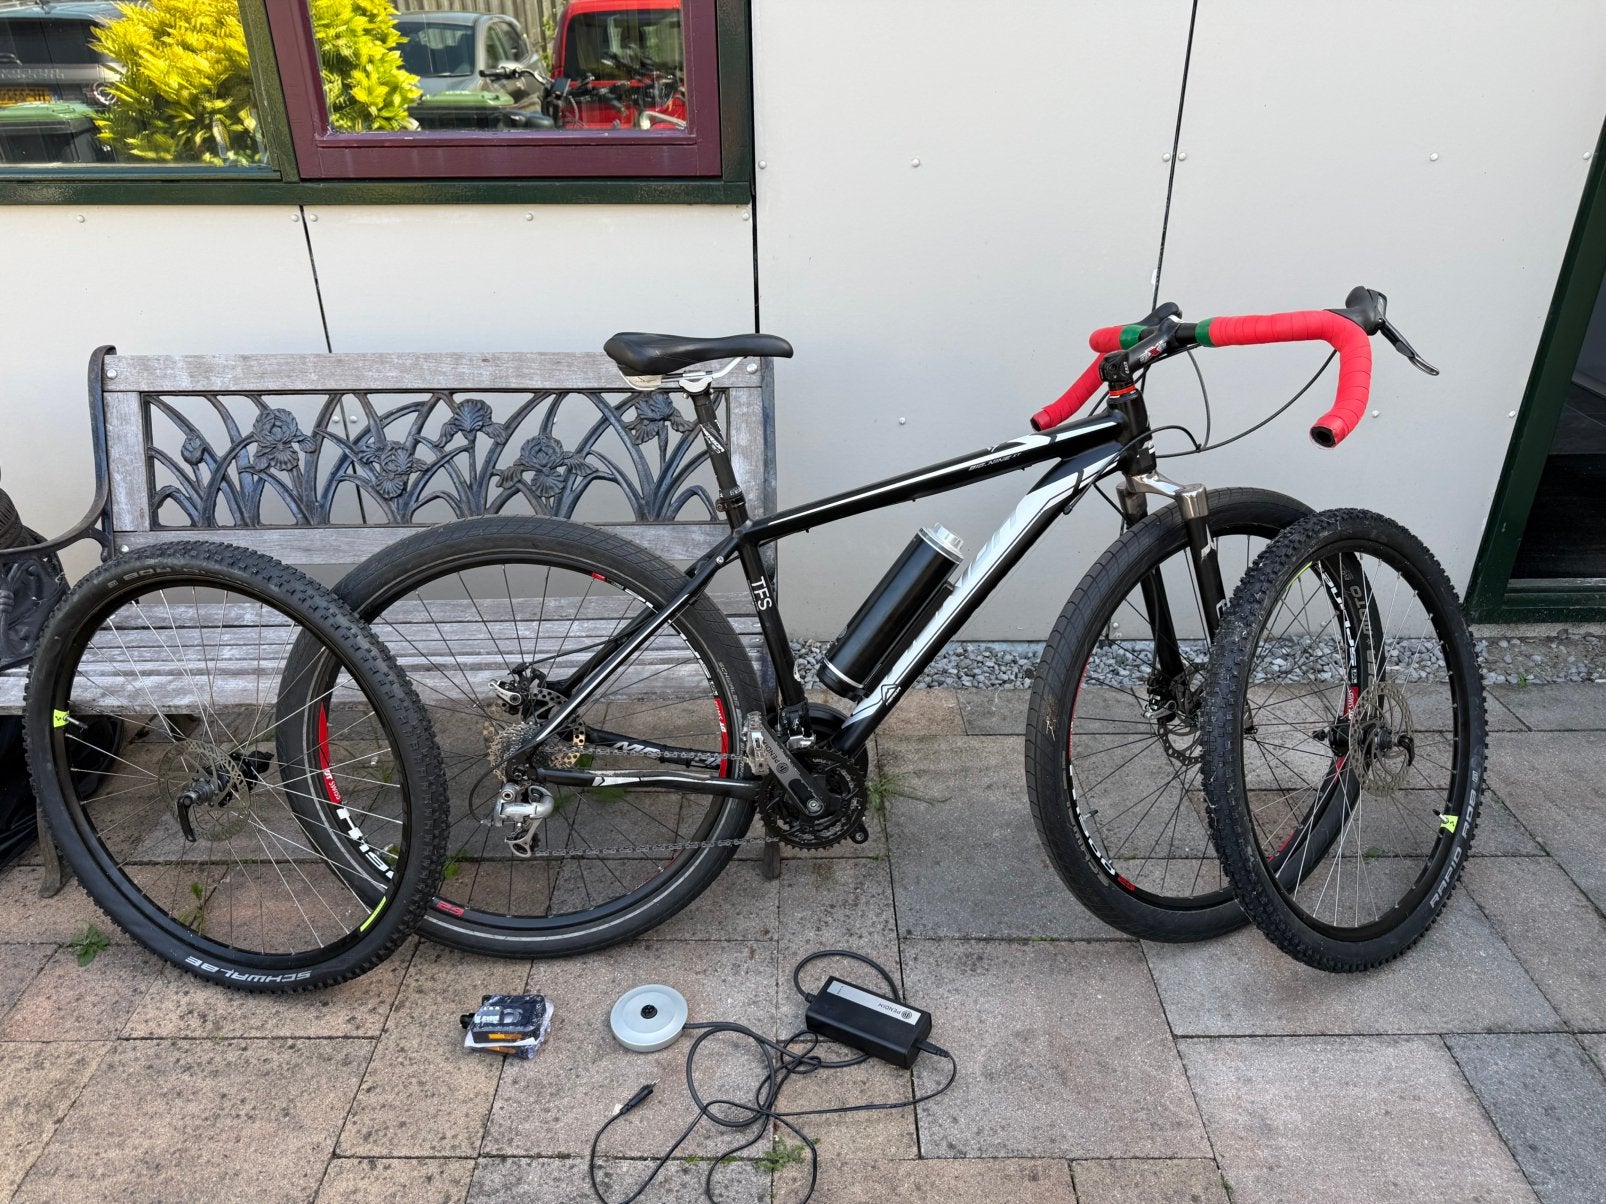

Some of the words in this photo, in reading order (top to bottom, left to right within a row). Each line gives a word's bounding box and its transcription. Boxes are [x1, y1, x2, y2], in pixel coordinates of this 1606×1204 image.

[751, 576, 772, 610] TFS
[718, 661, 740, 707] SCHWALBE
[1429, 846, 1462, 909] RAPID
[1461, 788, 1477, 840] ROB
[184, 955, 312, 983] SCHWALBE
[877, 1002, 901, 1016] PENDIX
